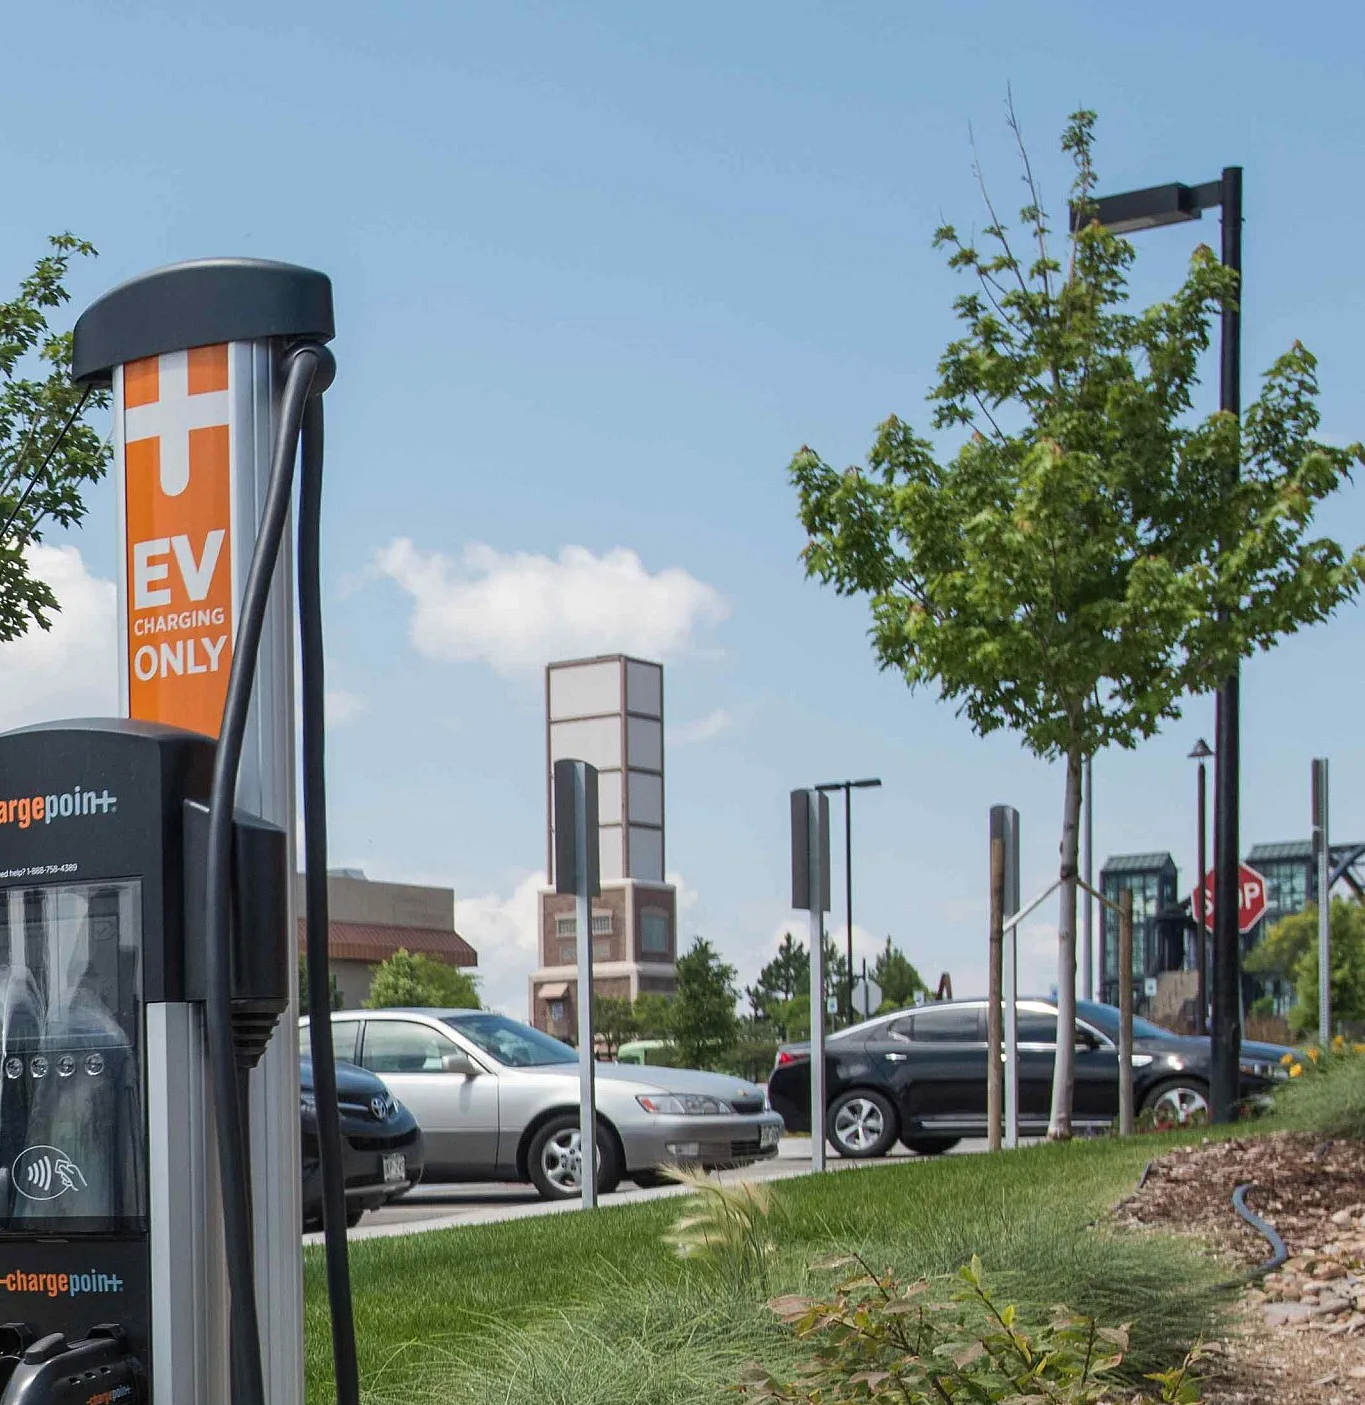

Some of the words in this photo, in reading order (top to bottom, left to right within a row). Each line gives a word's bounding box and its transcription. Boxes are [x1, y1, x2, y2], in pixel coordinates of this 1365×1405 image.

[134, 529, 226, 610] EV
[134, 608, 225, 636] CHARGING
[134, 635, 228, 681] ONLY
[9, 867, 26, 878] help?
[1205, 883, 1260, 916] SP
